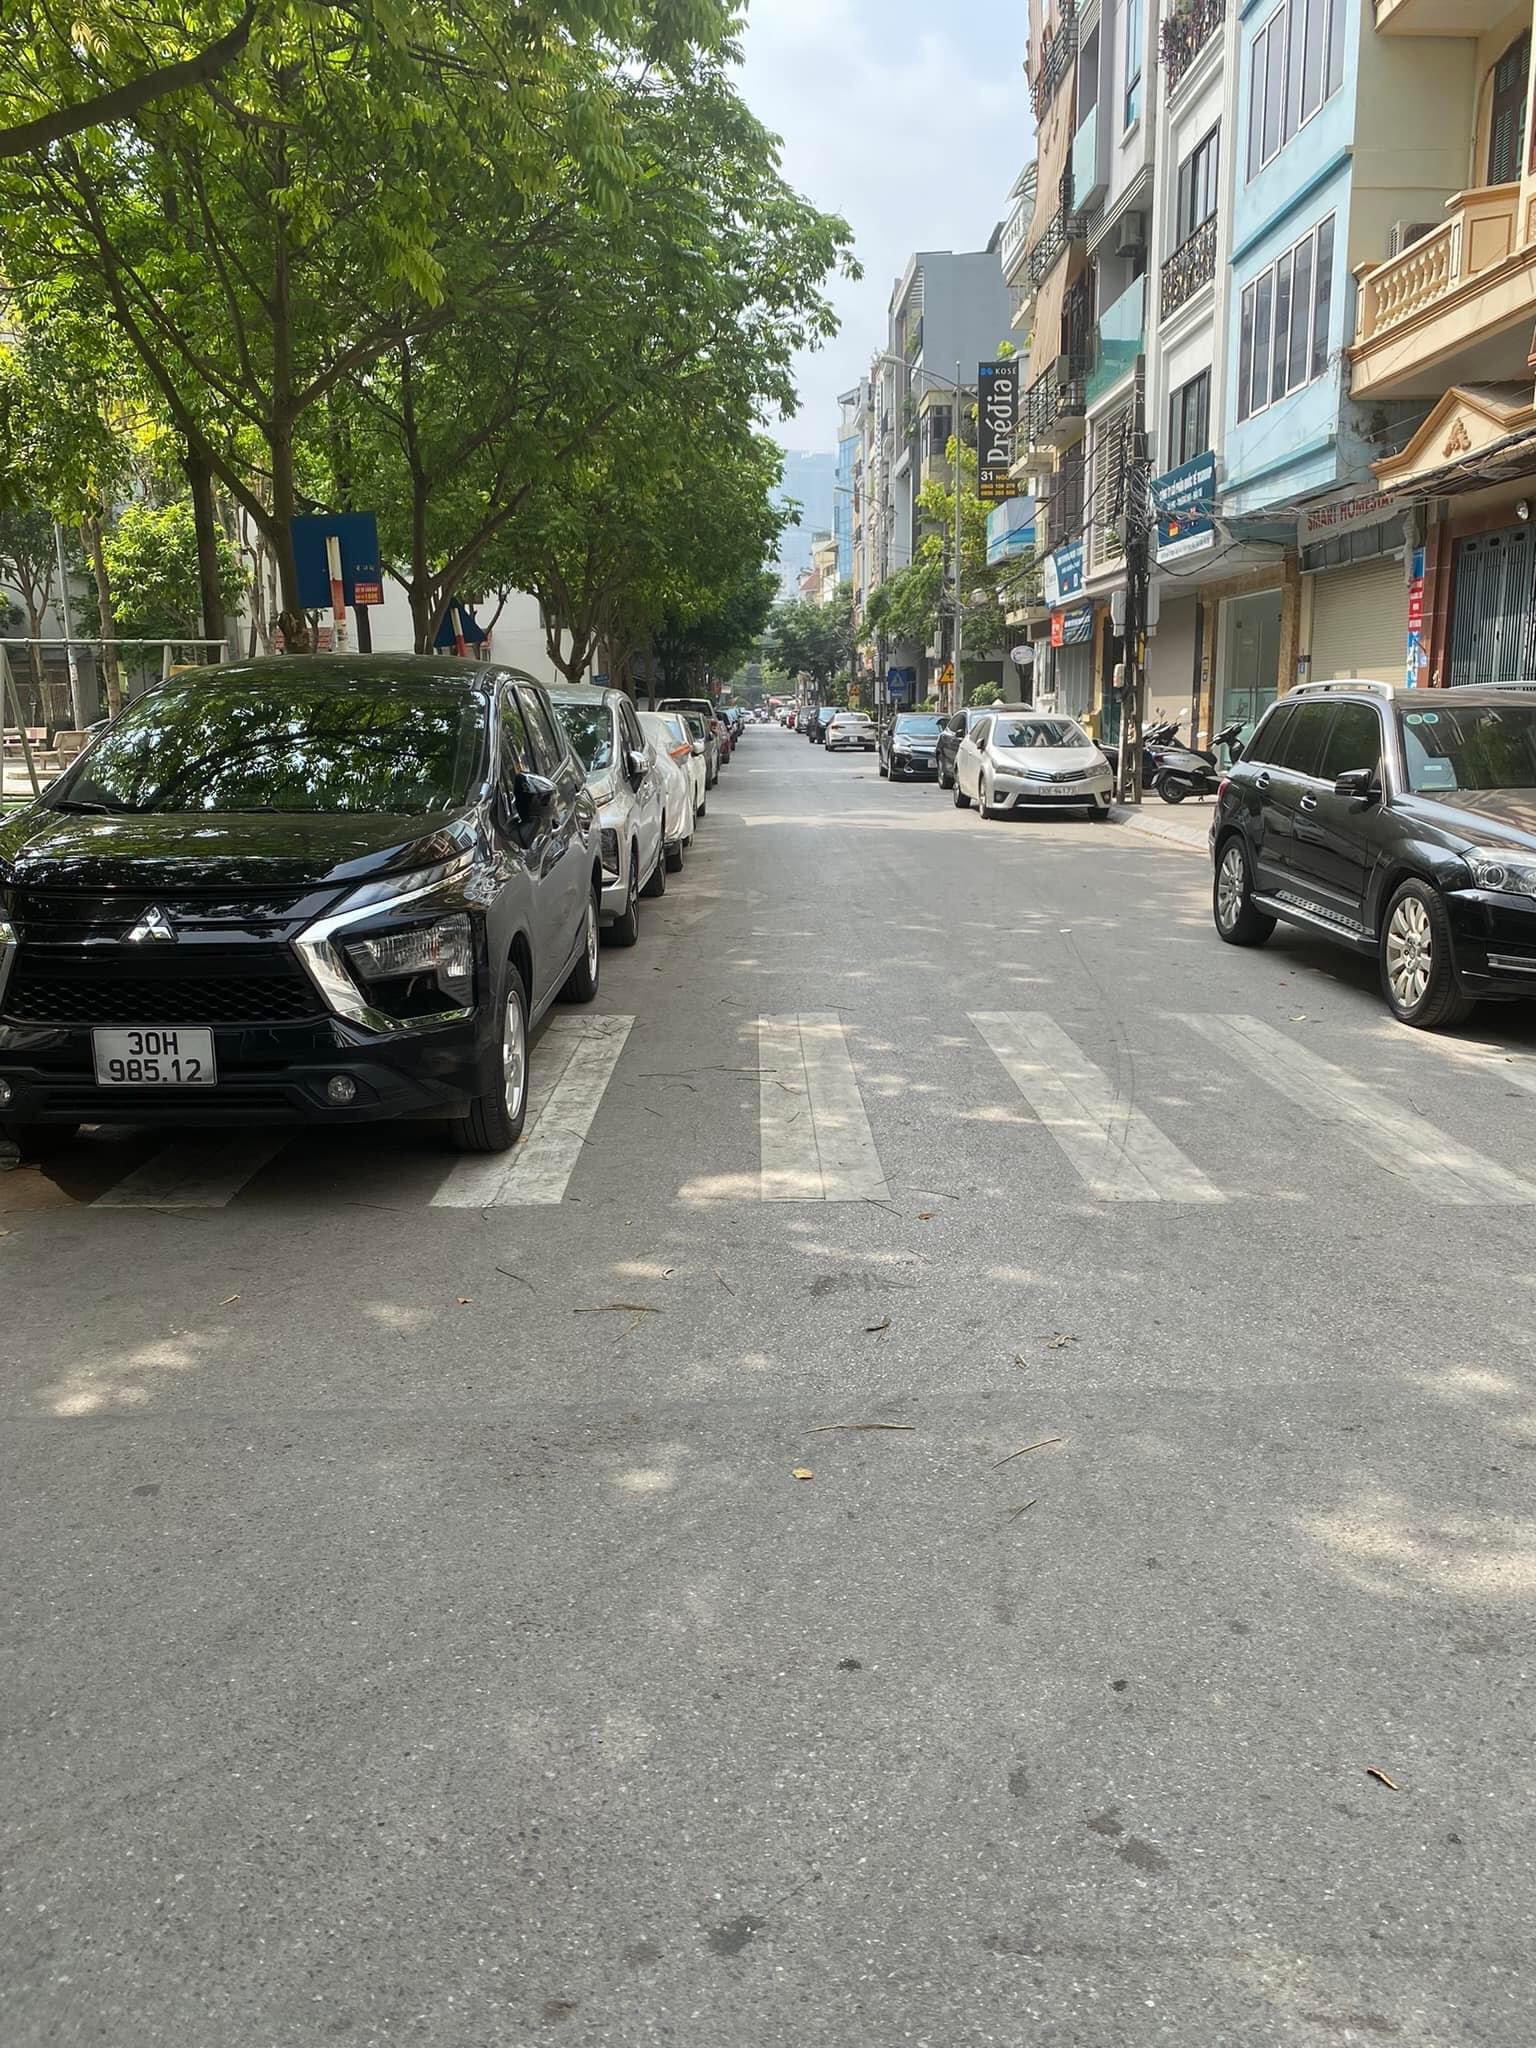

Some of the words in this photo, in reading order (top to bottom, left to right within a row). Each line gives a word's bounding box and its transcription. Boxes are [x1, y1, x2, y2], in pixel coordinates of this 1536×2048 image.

[985, 379, 1013, 463] Prédia
[980, 471, 993, 481] 31
[128, 1031, 179, 1056] 30H
[109, 1058, 203, 1083] 985.12
